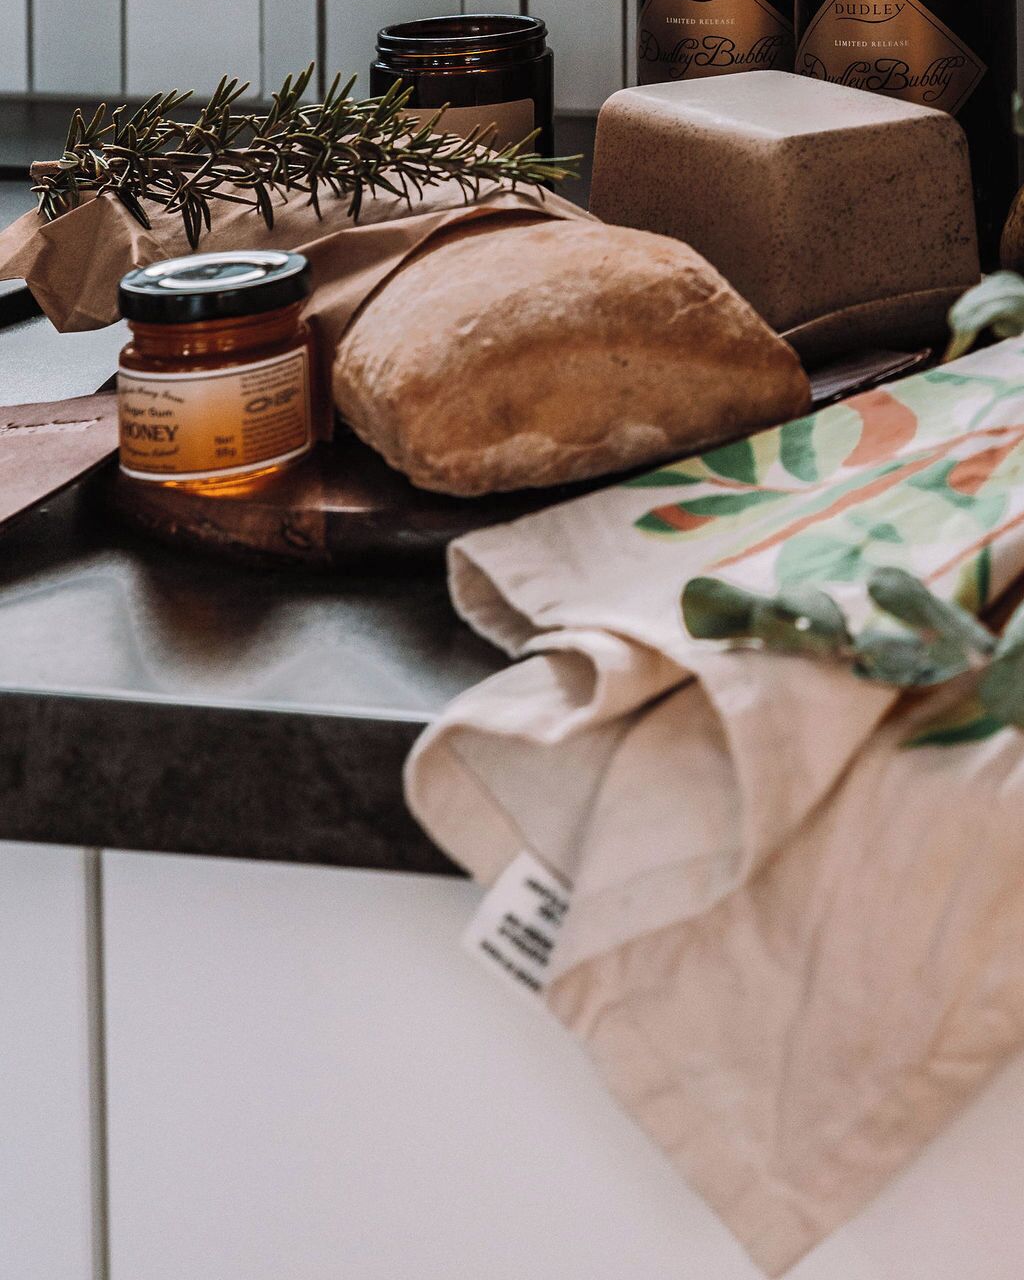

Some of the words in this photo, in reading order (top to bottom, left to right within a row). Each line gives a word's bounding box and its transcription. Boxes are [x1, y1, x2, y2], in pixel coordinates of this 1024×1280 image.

[834, 3, 906, 20] DUDLEY
[666, 17, 696, 25] LIMITED
[834, 39, 868, 48] LIMITED
[865, 55, 965, 102] Bubbly
